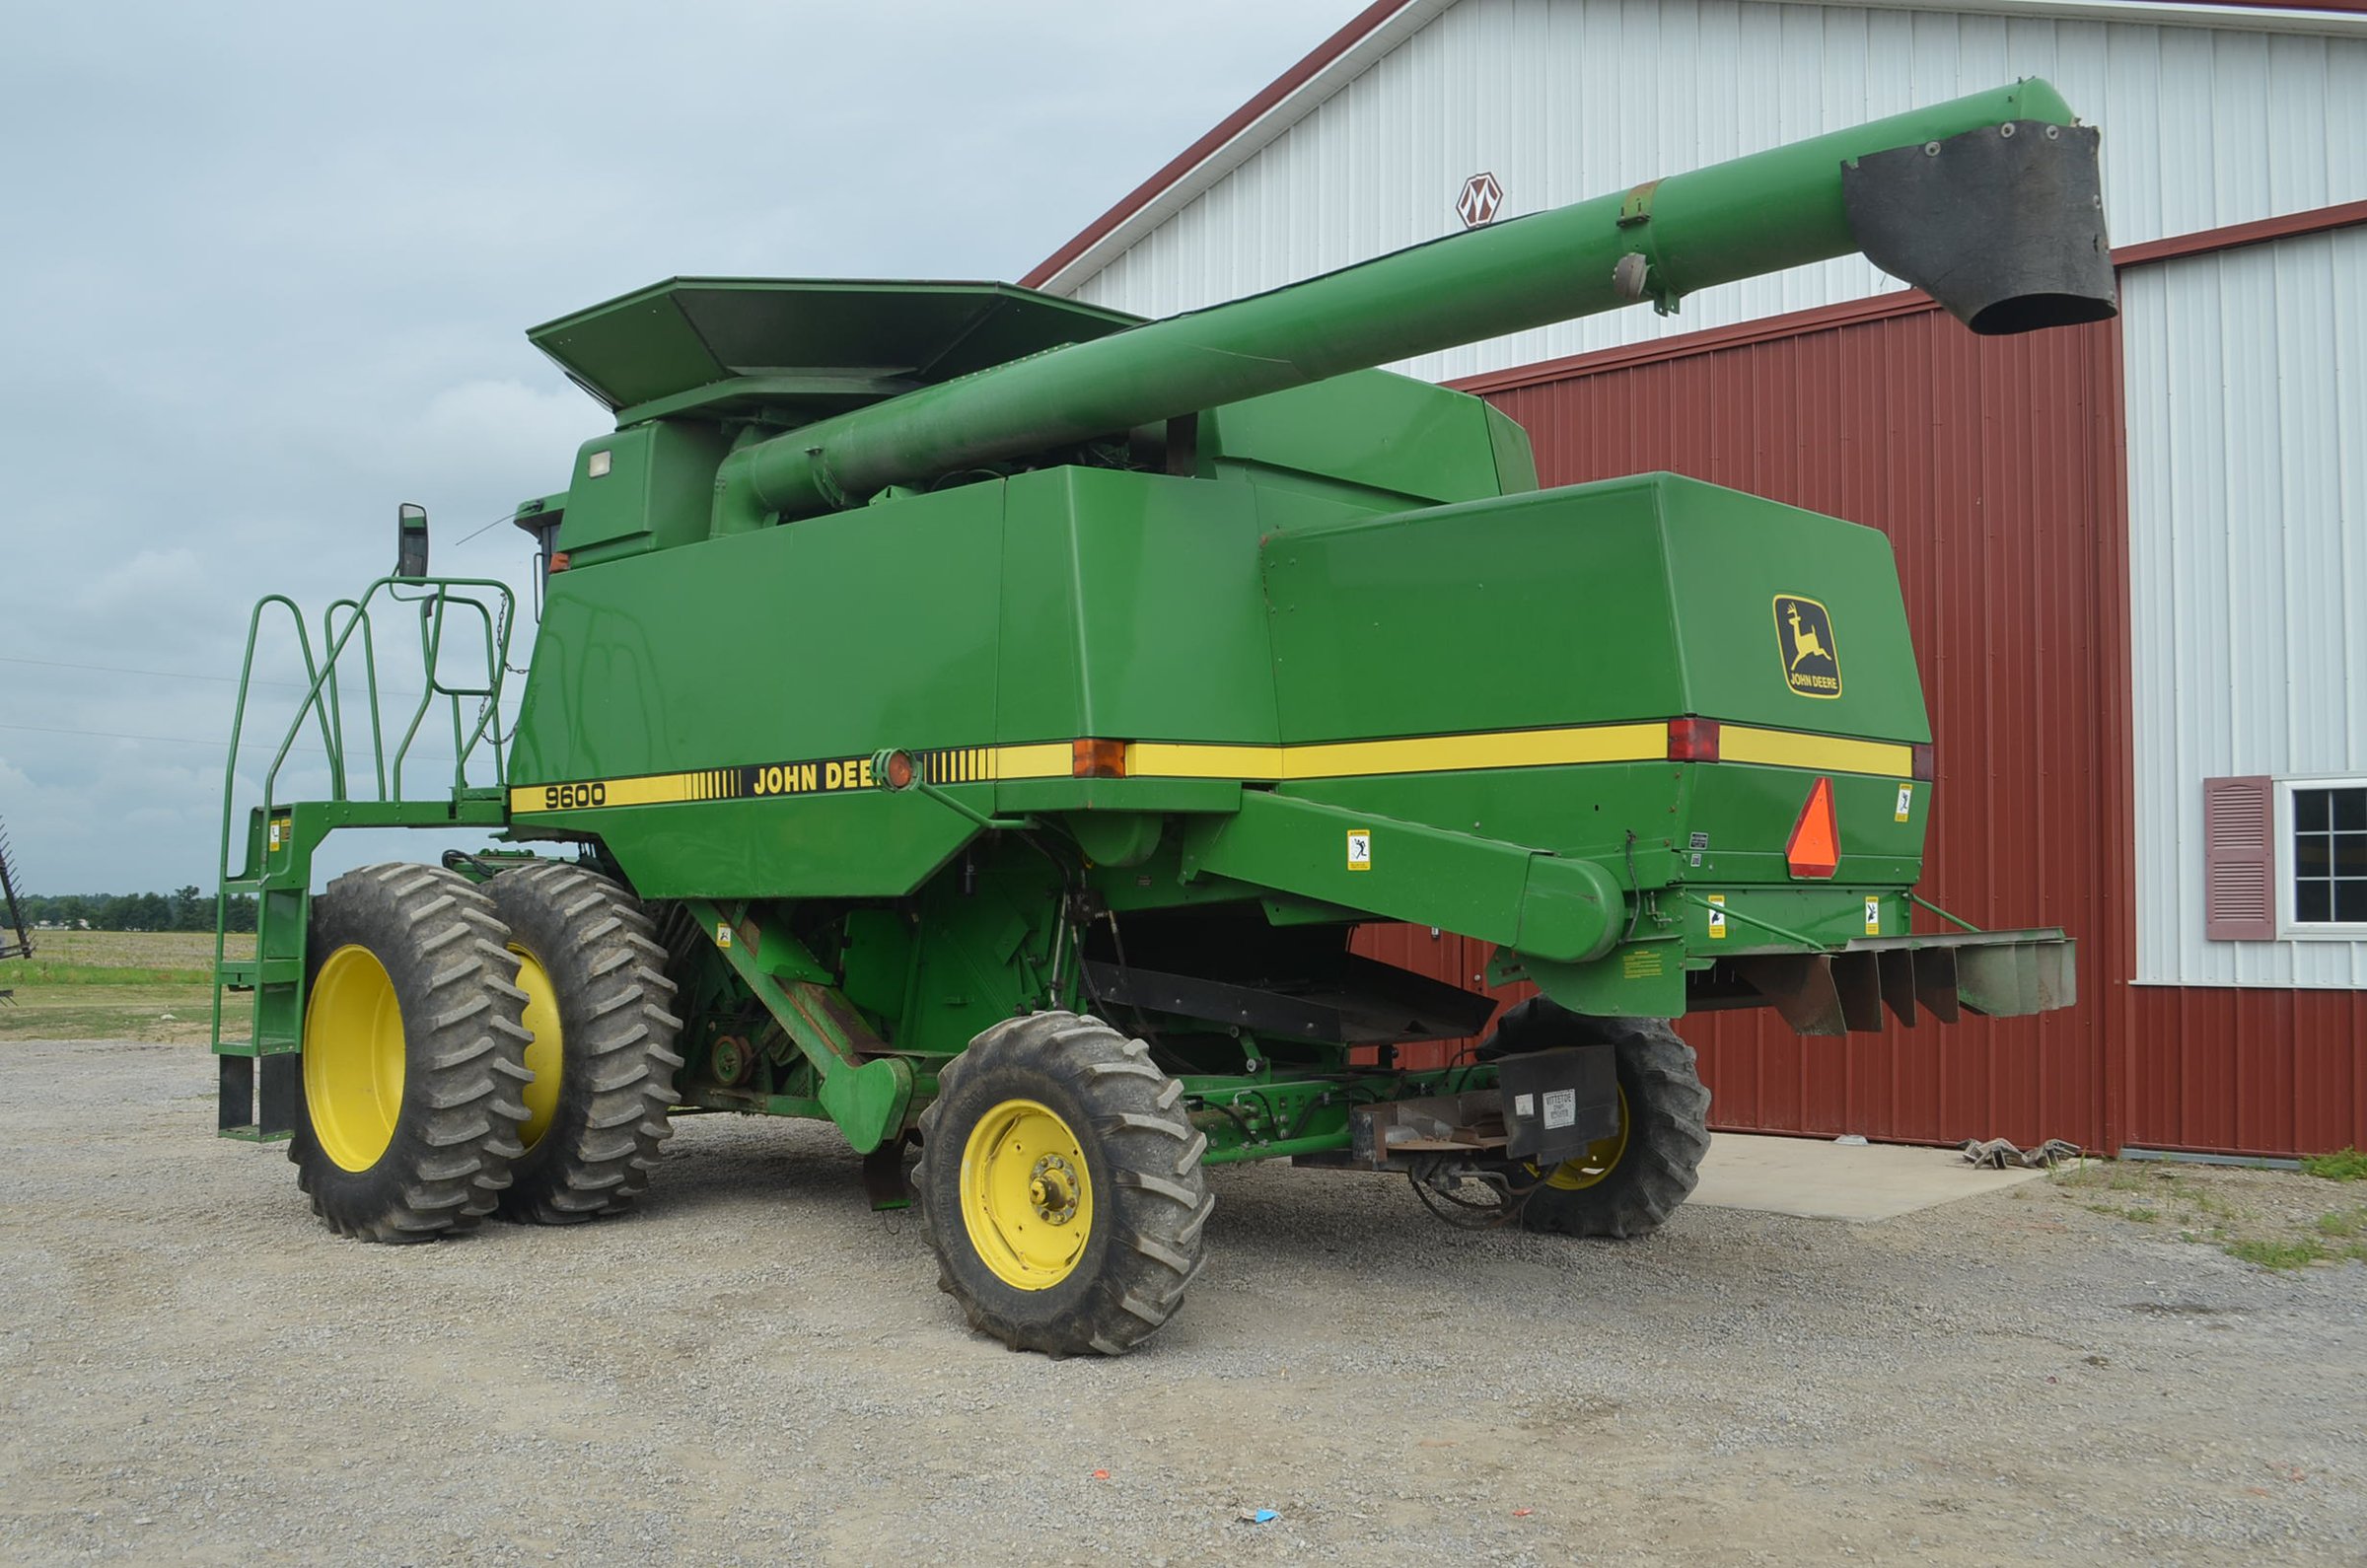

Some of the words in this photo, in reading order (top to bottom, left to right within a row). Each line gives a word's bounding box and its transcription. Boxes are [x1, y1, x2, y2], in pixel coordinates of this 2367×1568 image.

[1790, 673, 1812, 686] JOHN
[1812, 675, 1838, 689] DEERE
[753, 763, 818, 795] JOHN
[825, 758, 881, 790] DEE
[545, 782, 606, 809] 9600
